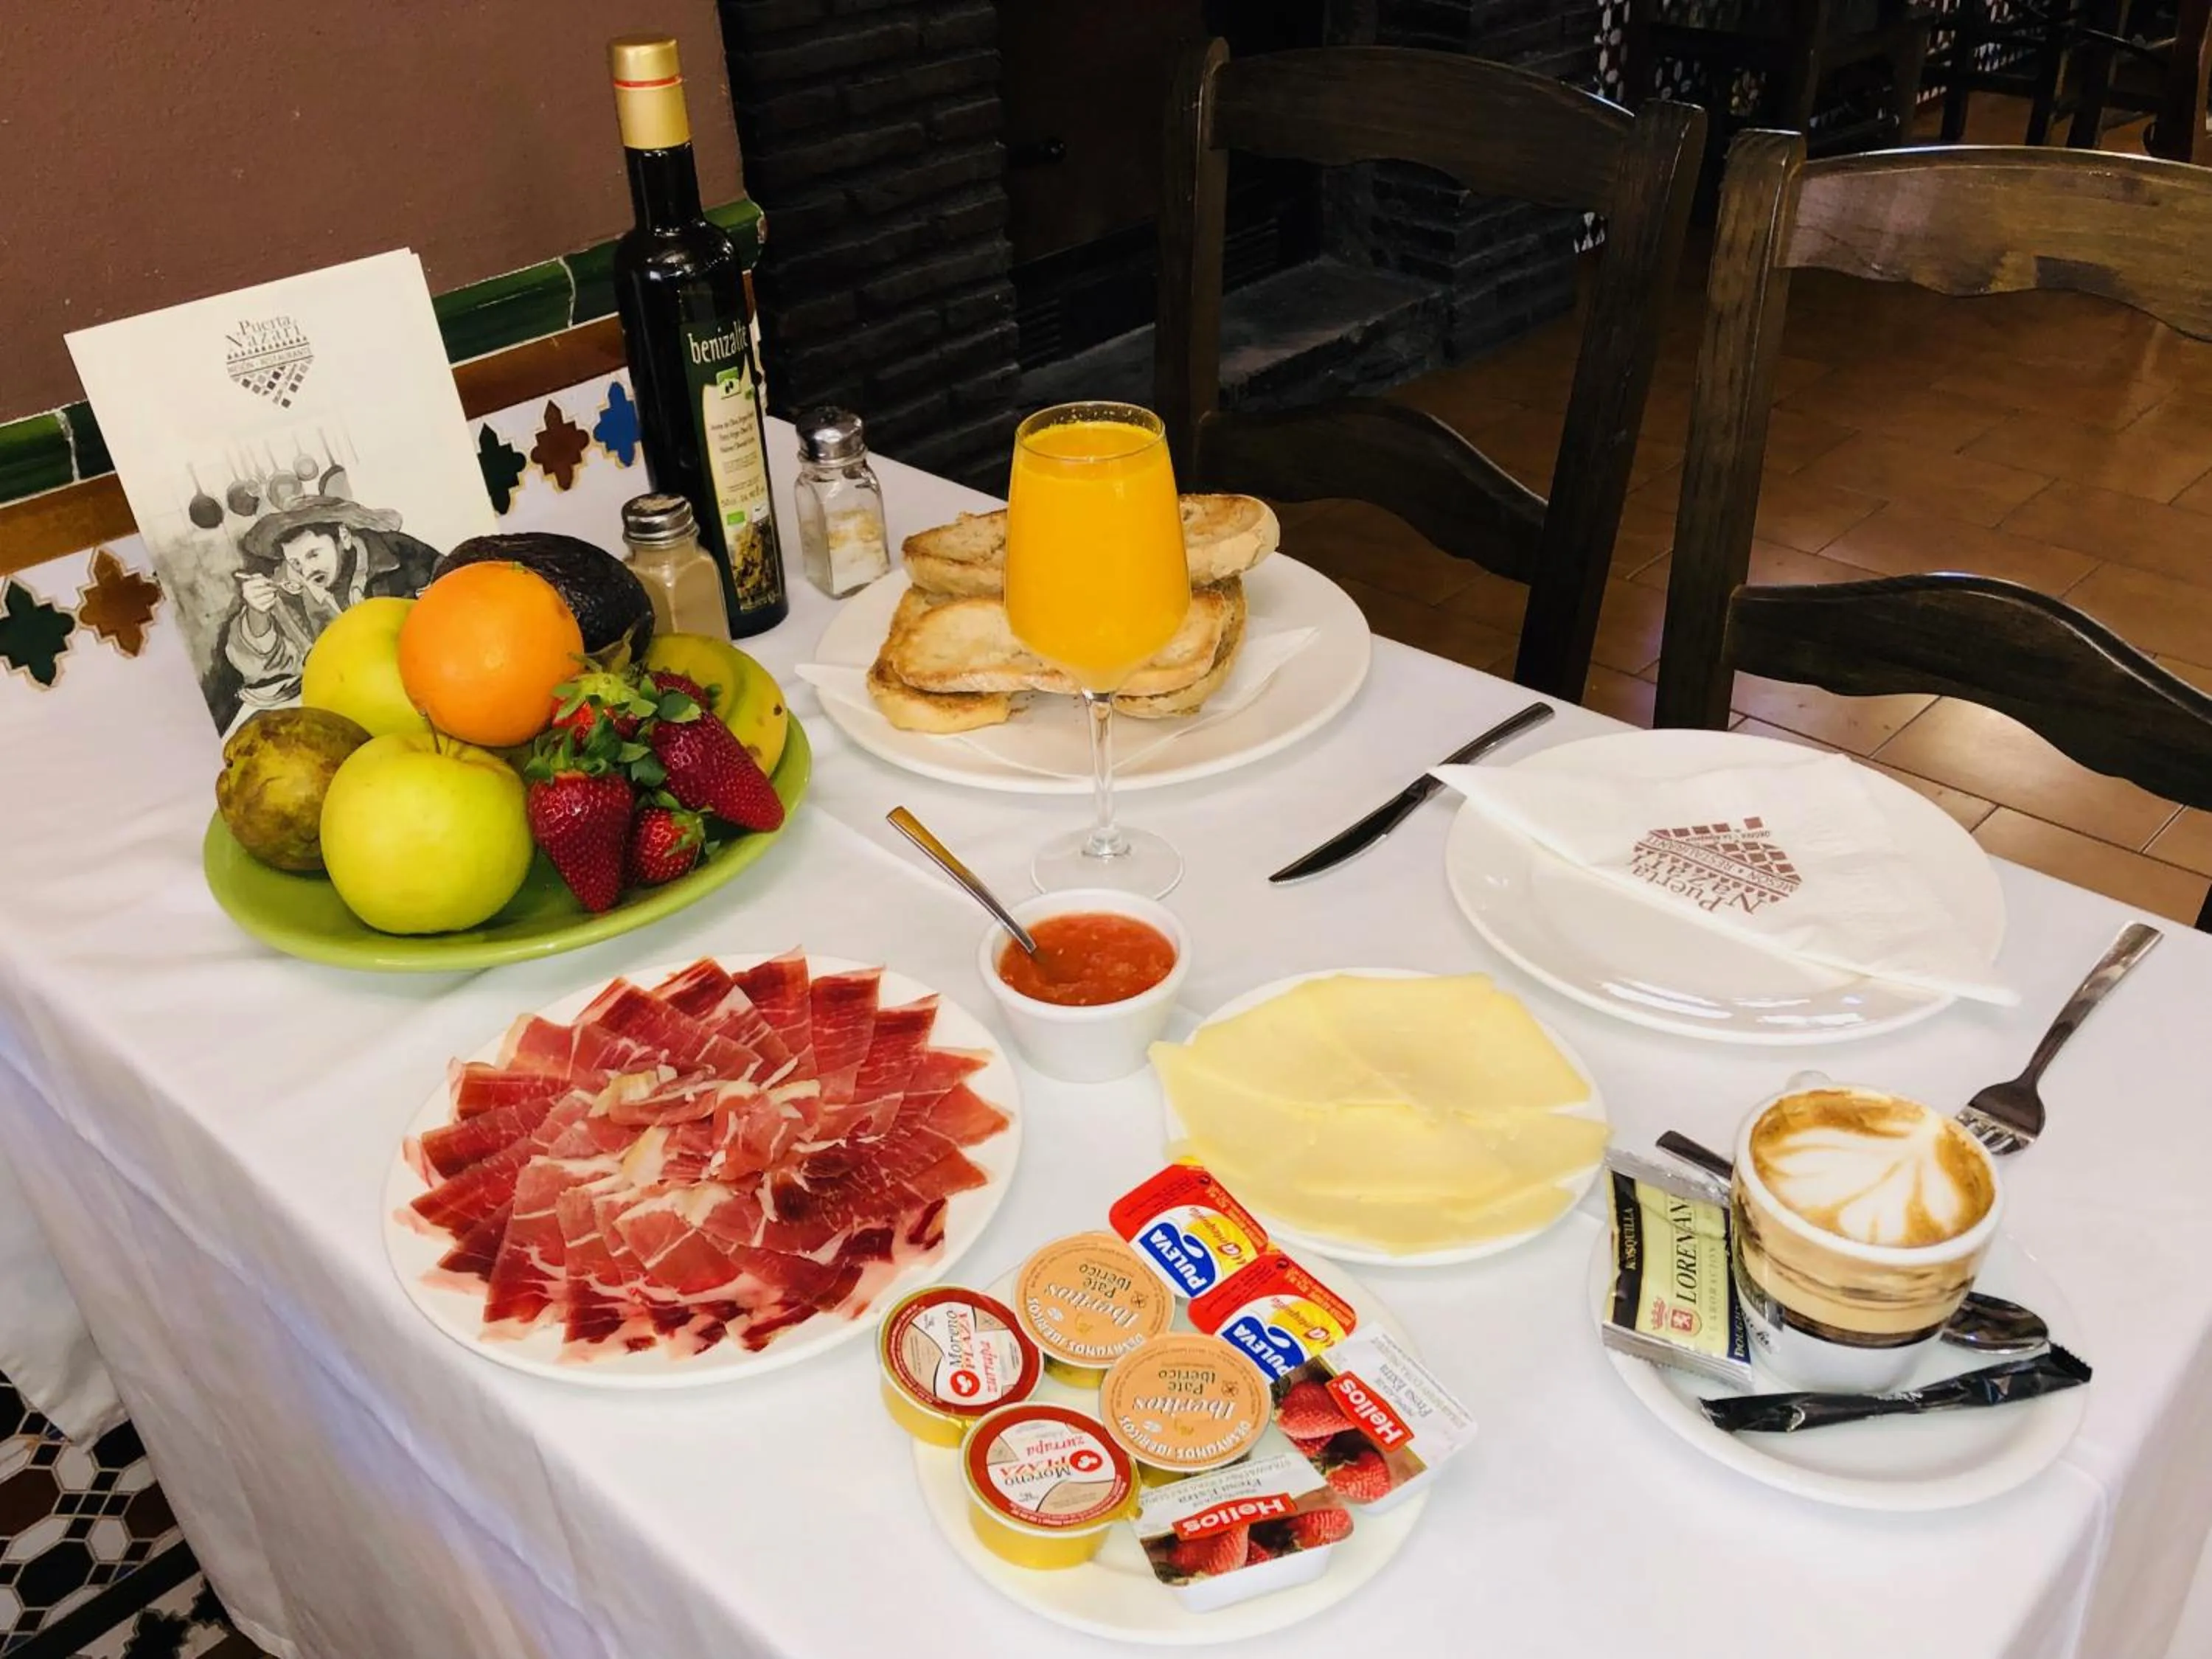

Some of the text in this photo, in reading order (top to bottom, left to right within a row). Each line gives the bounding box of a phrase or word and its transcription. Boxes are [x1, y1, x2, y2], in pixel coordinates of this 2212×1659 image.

[1632, 865, 1725, 911] Puerta
[1150, 1228, 1207, 1290] PULEVA
[1044, 1281, 1139, 1329] Iberitos
[946, 1310, 962, 1368] Moreno
[958, 1310, 975, 1369] PLAZA
[1233, 1324, 1295, 1377] PULEVA
[1133, 1394, 1237, 1420] Iberitos
[1338, 1378, 1404, 1444] Helios
[998, 1455, 1067, 1477] PLAZA
[1026, 1436, 1086, 1456] zurrapa
[1004, 1465, 1071, 1486] Moreno
[1182, 1498, 1287, 1534] Helios
